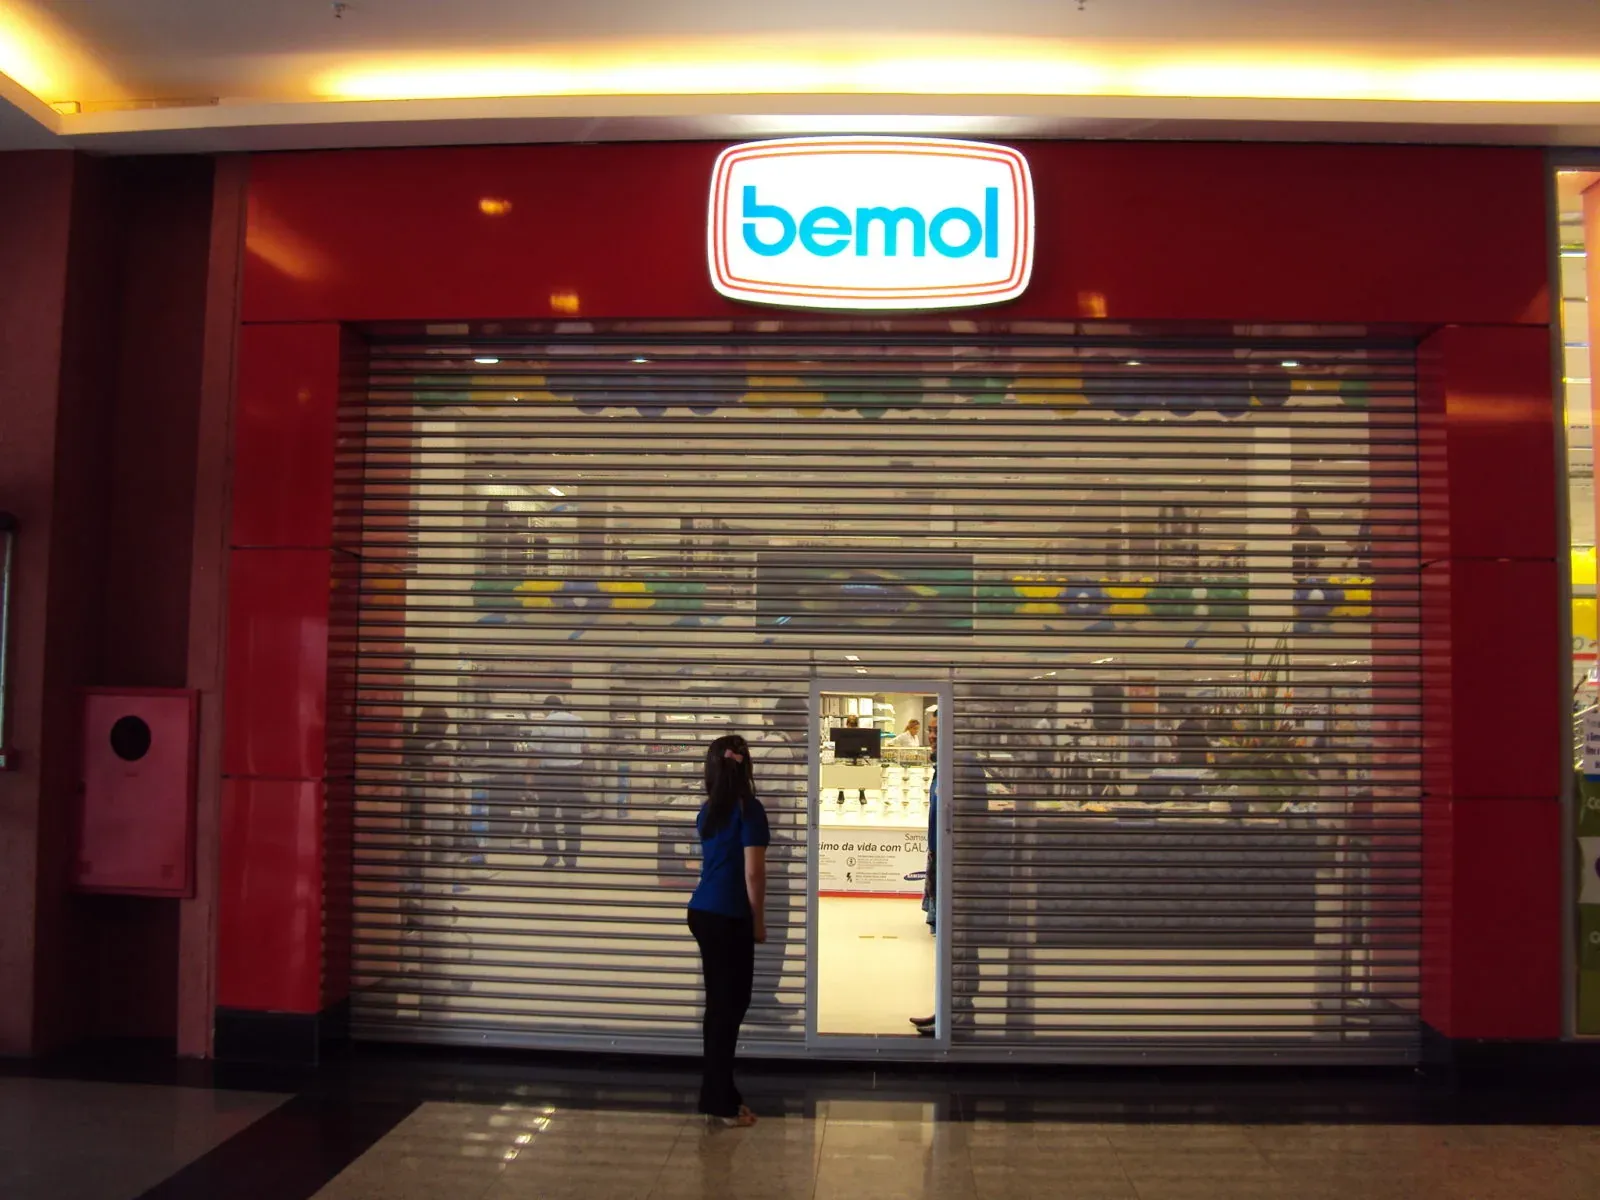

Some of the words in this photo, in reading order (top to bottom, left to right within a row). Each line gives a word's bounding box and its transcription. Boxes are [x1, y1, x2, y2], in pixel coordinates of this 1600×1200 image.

[742, 185, 998, 258] bemol
[842, 842, 854, 851] da
[857, 842, 877, 852] vida
[880, 844, 901, 852] com
